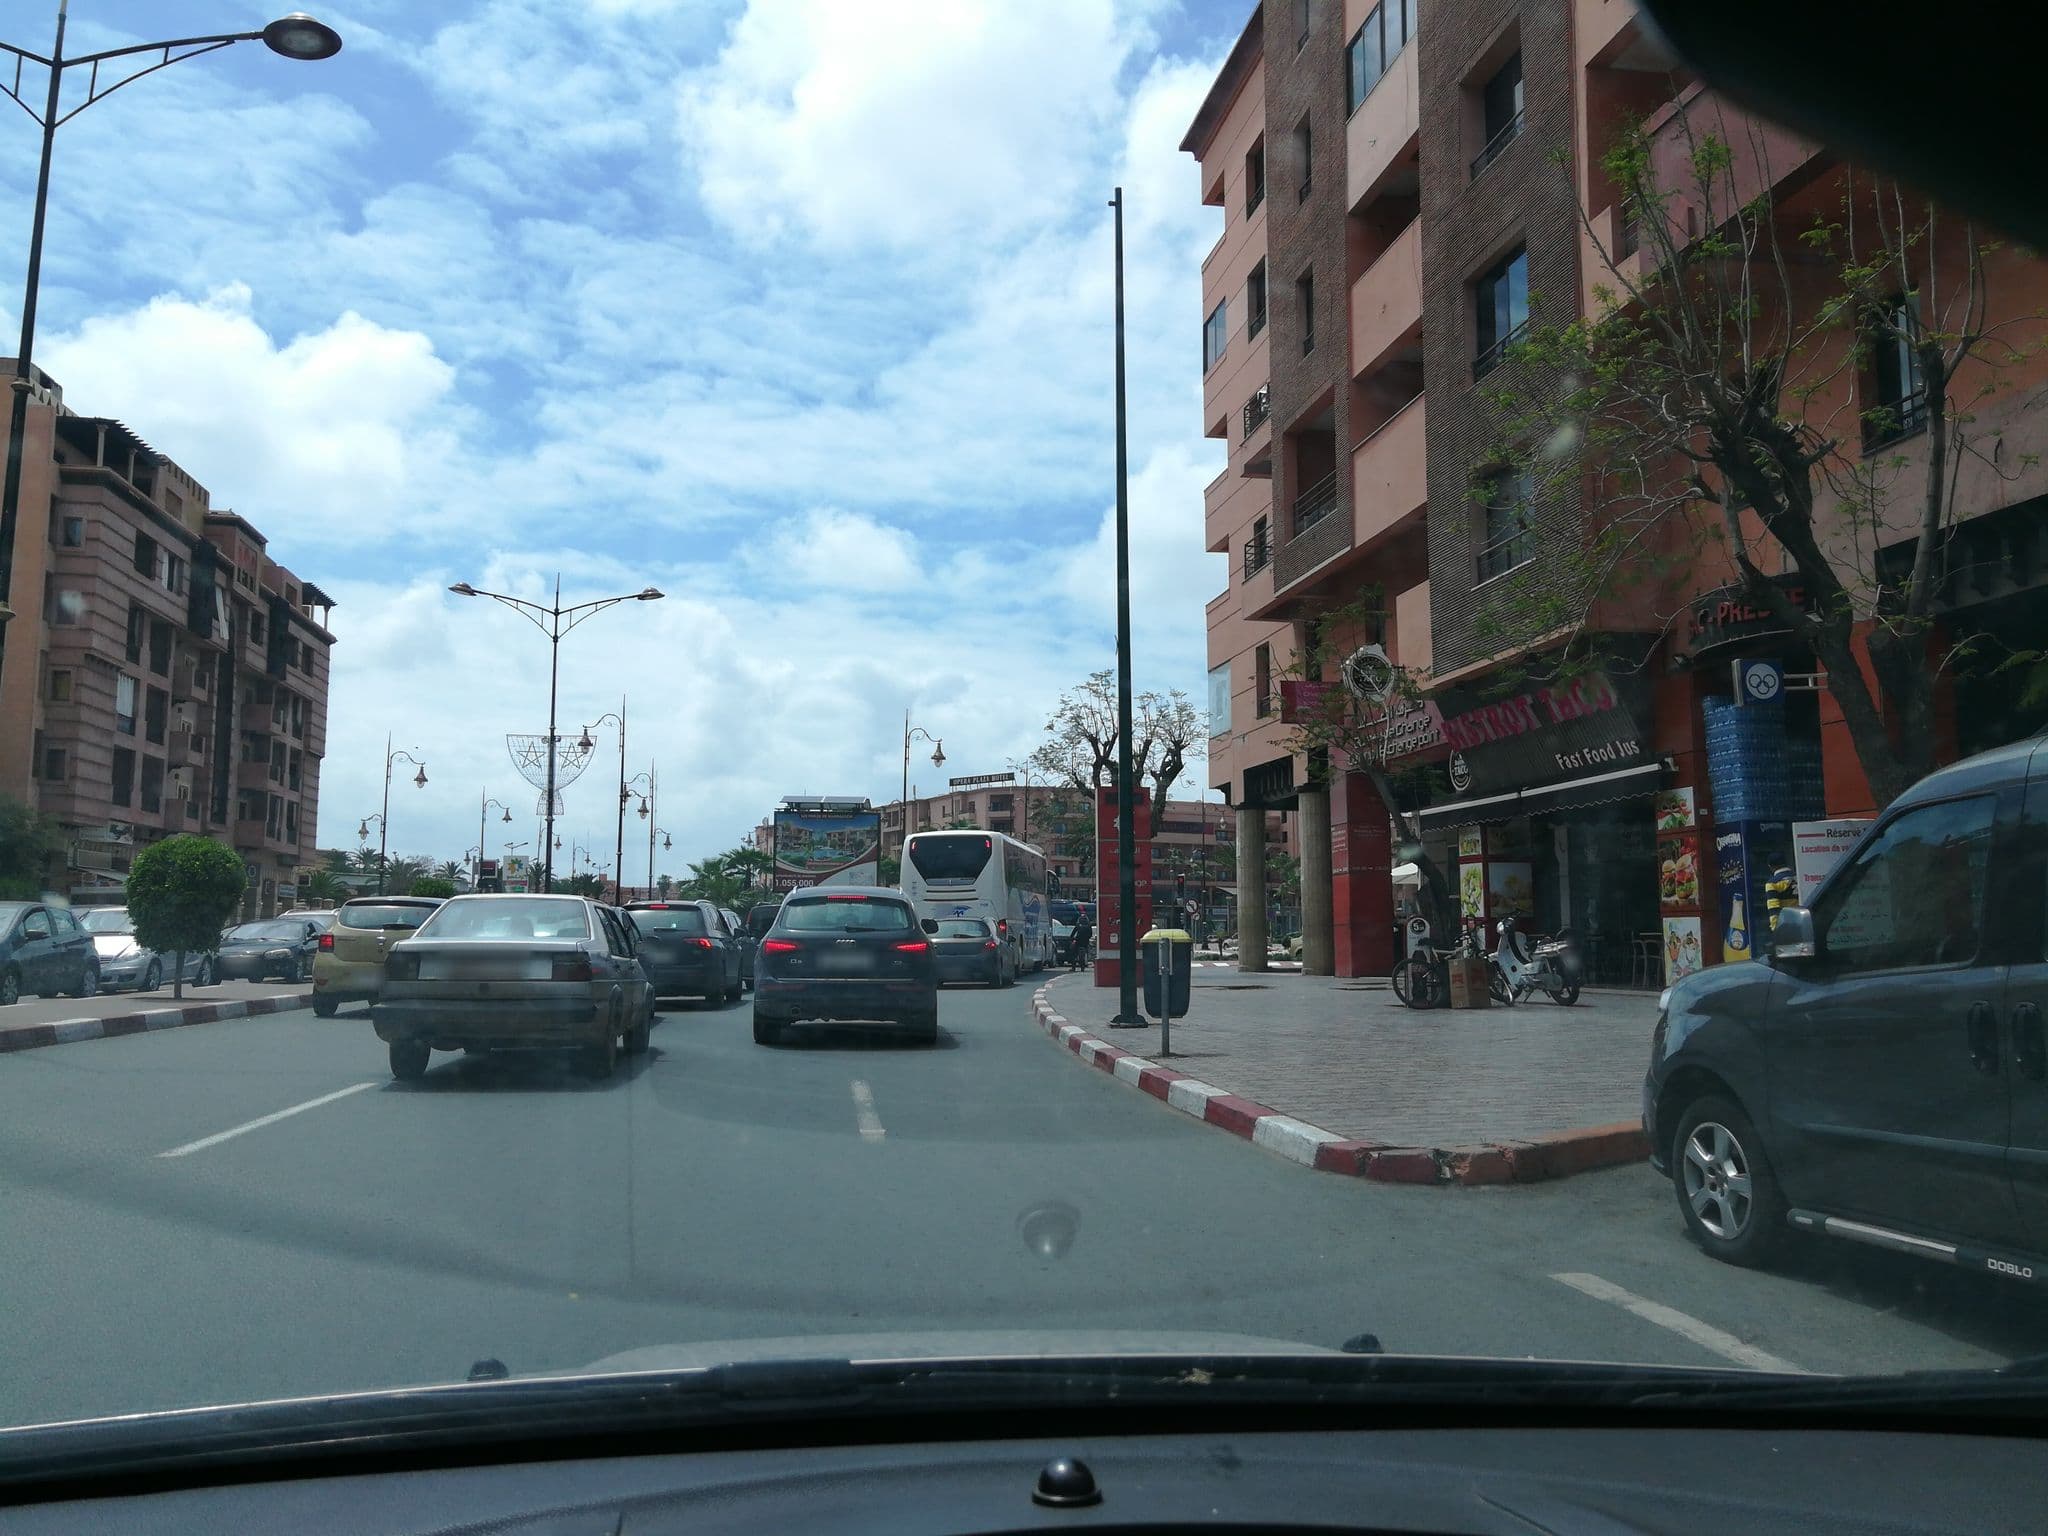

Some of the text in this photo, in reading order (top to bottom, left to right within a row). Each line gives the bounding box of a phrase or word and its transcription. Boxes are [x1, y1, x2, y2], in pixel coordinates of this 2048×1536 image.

[1554, 738, 1640, 771] Fast Food Jus
[1987, 1257, 2033, 1278] DOBLO
